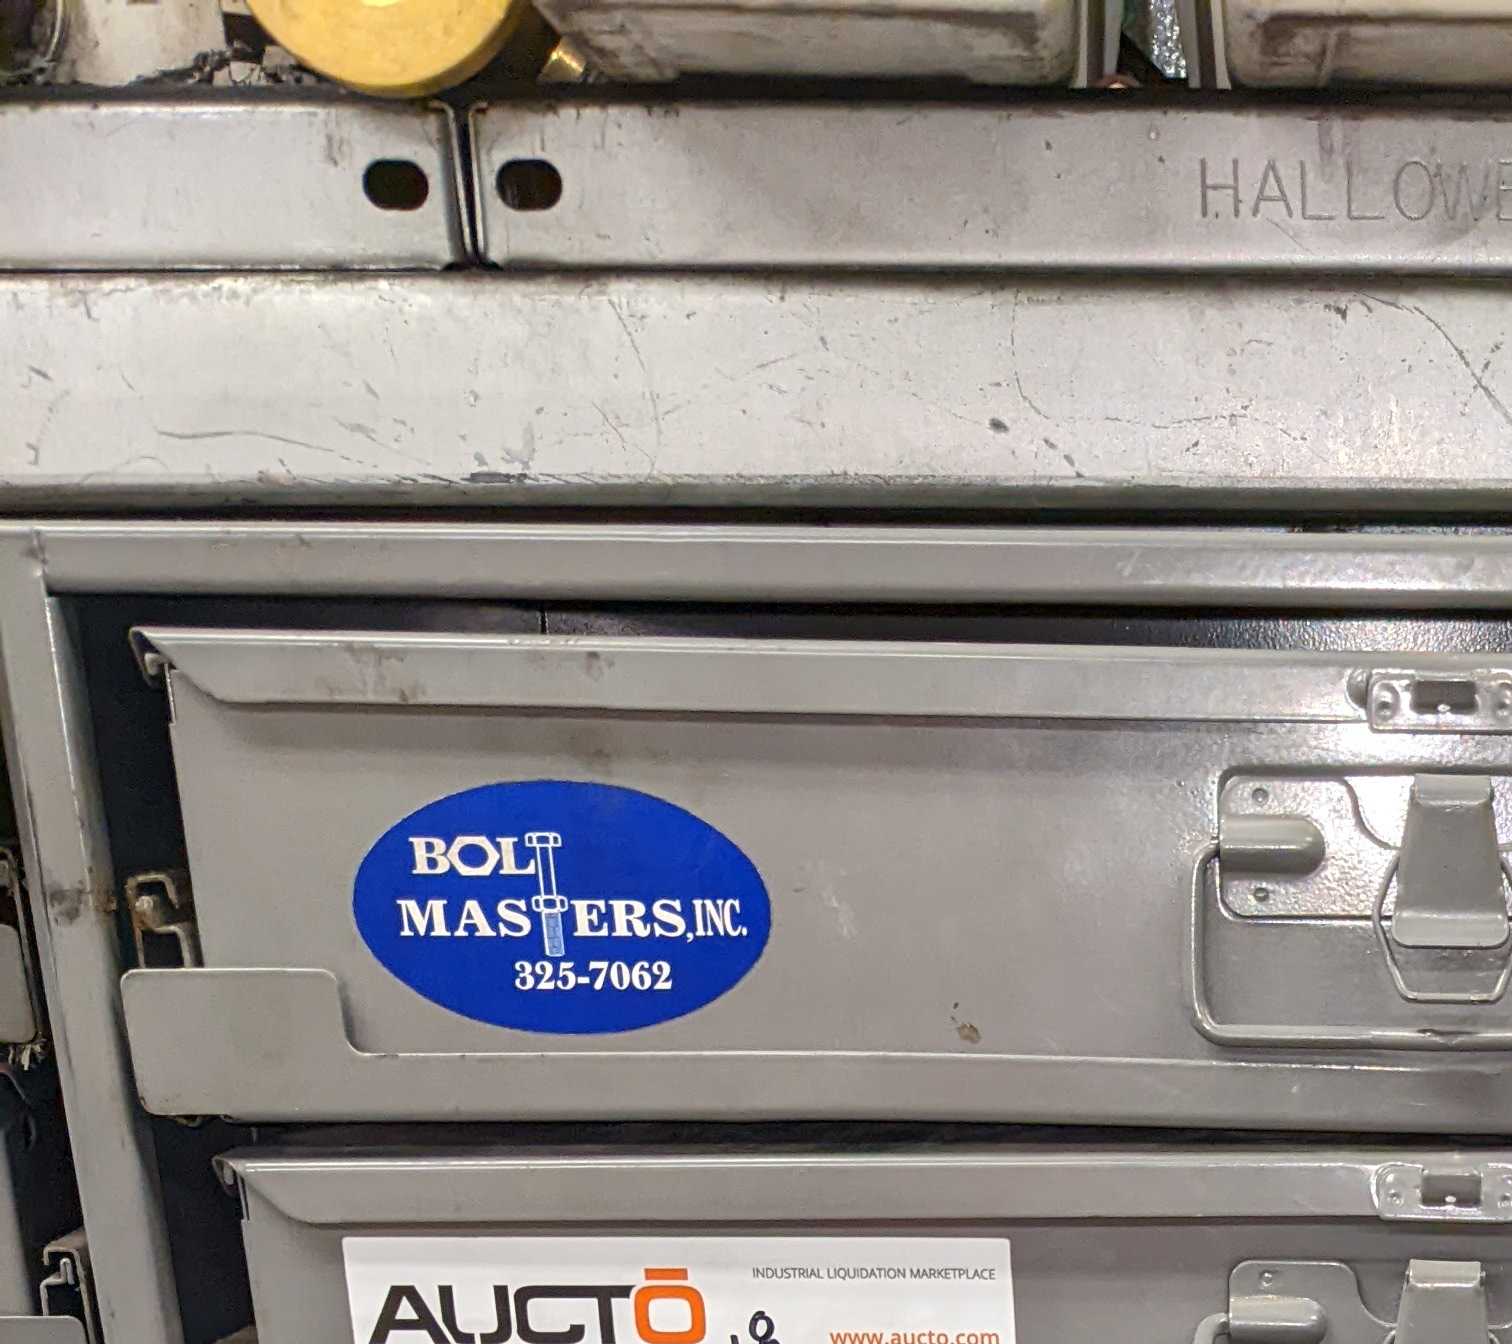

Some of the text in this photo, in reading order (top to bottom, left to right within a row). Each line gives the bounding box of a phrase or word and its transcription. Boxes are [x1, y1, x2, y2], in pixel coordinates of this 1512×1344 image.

[514, 960, 673, 992] 325-7062
[752, 1267, 997, 1281] INDUSTRIAL LIQUIDATION MARKETPLACE
